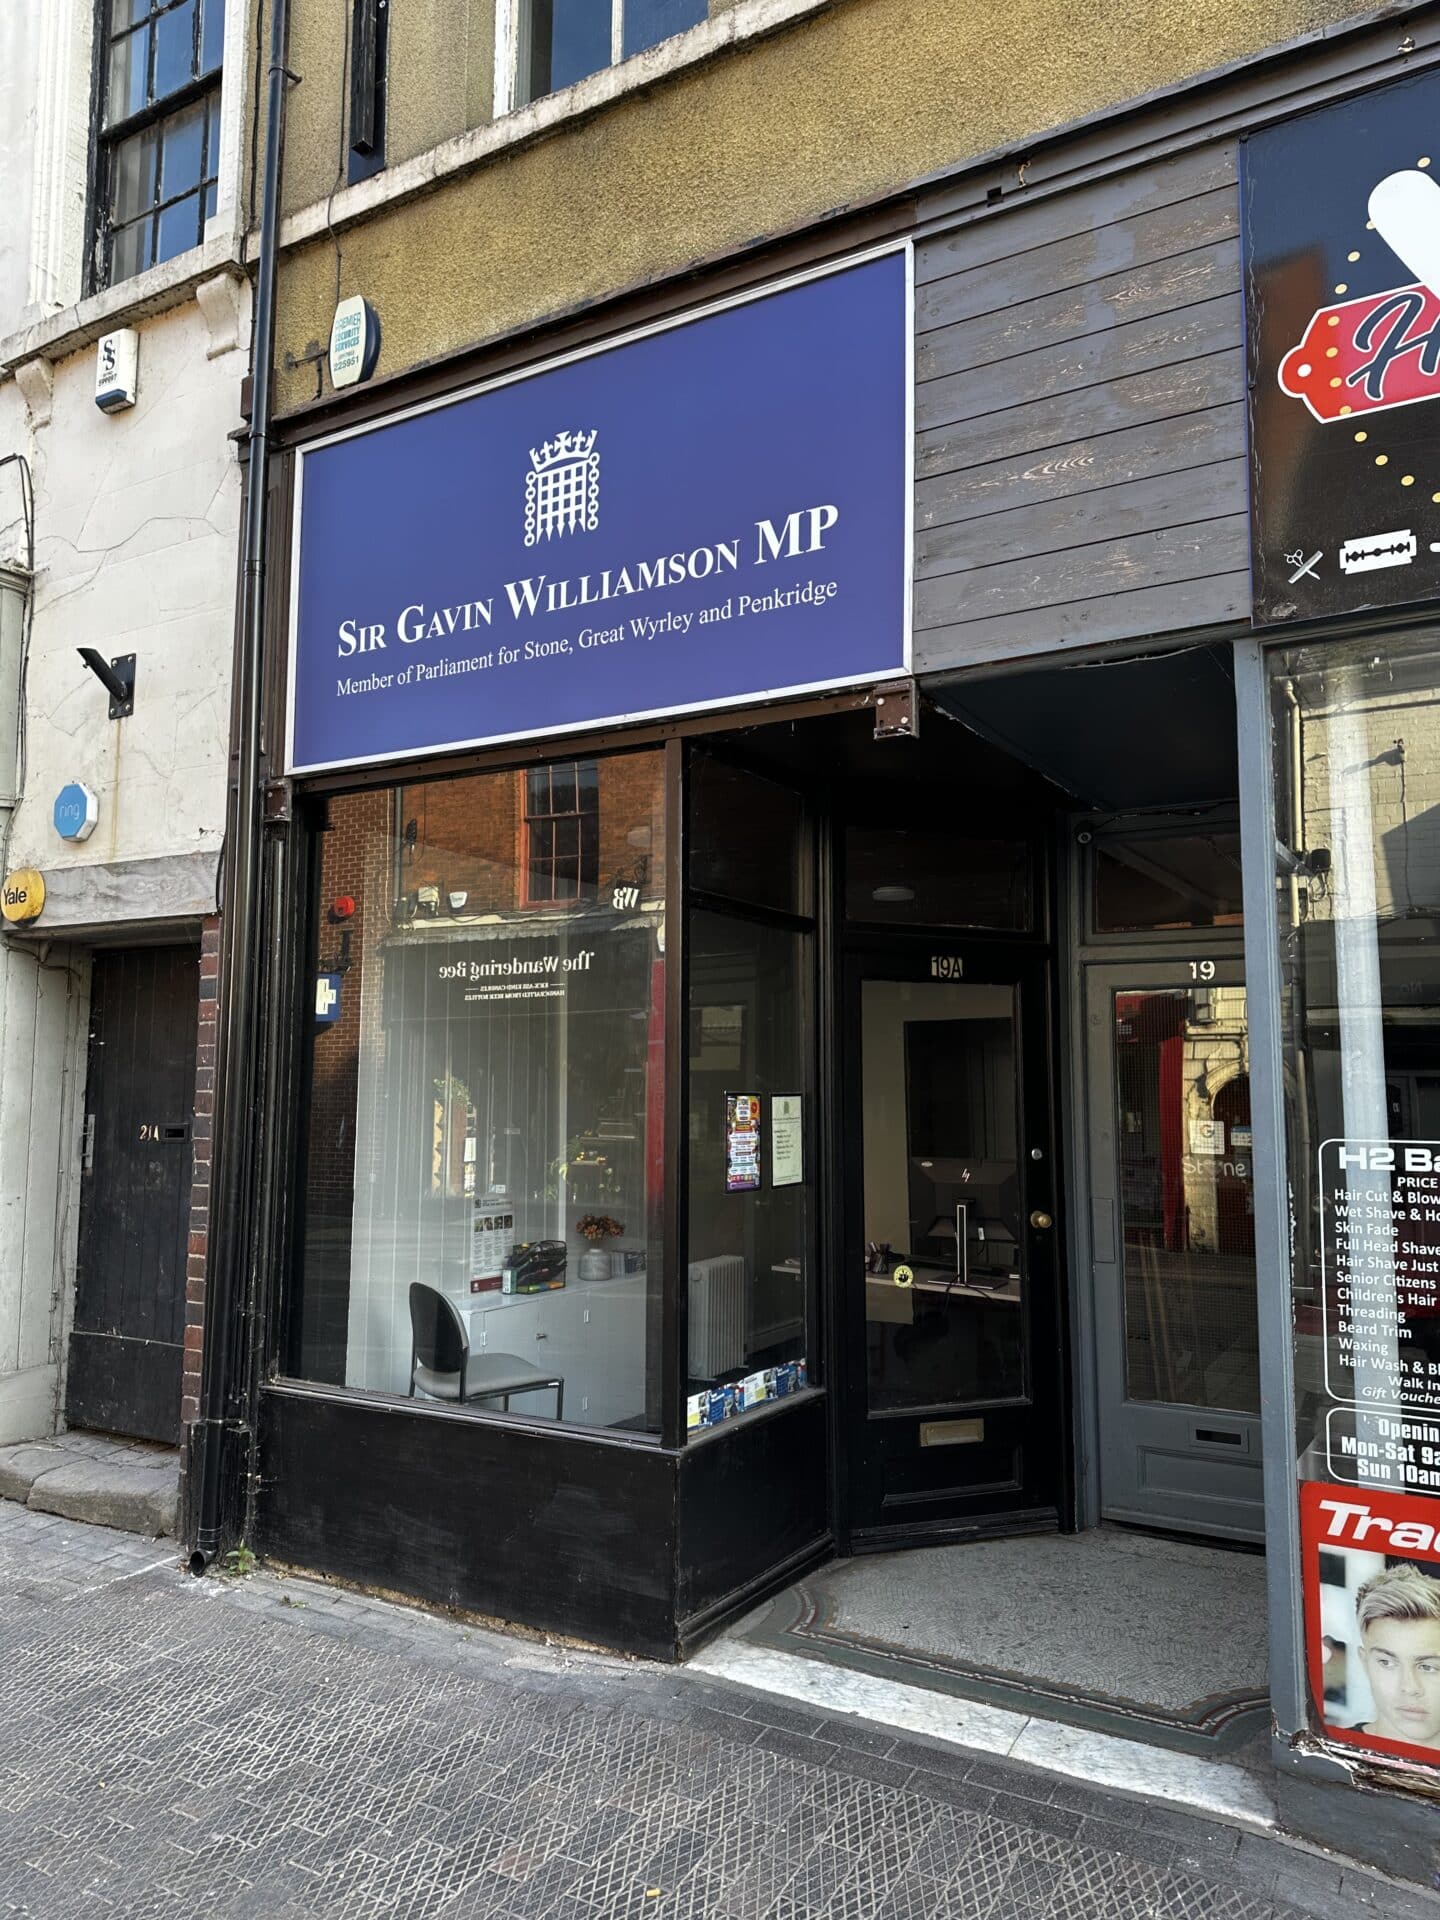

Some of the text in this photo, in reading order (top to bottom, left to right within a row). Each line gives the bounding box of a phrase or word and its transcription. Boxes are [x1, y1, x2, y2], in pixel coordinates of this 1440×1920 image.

[336, 336, 360, 352] SERVICES
[334, 356, 359, 371] 225951
[338, 504, 839, 657] SIR GAVIN WILLIAMSON MP
[337, 580, 838, 696] Member of Parliament for Stone, Great Wyrley and Penkridge
[60, 803, 80, 820] ring
[3, 887, 27, 905] Yale
[931, 956, 962, 978] 19A
[1189, 960, 1216, 981] 19
[1182, 1156, 1246, 1177] Stne
[1338, 1147, 1395, 1171] H2
[1397, 1177, 1438, 1188] PRICE
[1334, 1189, 1440, 1204] Hair Cut & Blow
[1335, 1205, 1363, 1218] Wet
[1366, 1207, 1406, 1220] Shave
[1410, 1208, 1421, 1220] &
[1335, 1222, 1399, 1236] Skin Fade
[1336, 1238, 1440, 1255] Full Head Shave
[1336, 1255, 1438, 1272] Hair Shave Just
[1336, 1271, 1436, 1289] Senior Citizens
[1337, 1288, 1437, 1306] Children's Hair
[1337, 1304, 1406, 1323] Threading
[1339, 1321, 1412, 1338] Beard Trim
[1339, 1338, 1388, 1356] Waxing
[1340, 1354, 1366, 1367] Hair
[1371, 1357, 1408, 1372] Wash
[1413, 1361, 1424, 1374] &
[1388, 1375, 1424, 1389] Walk
[1362, 1387, 1440, 1404] Gift Vouche
[1378, 1418, 1440, 1442] Openin
[1342, 1436, 1415, 1463] Mon-Sat
[1357, 1458, 1440, 1486] Sun 10am
[1319, 1500, 1440, 1552] Tra
